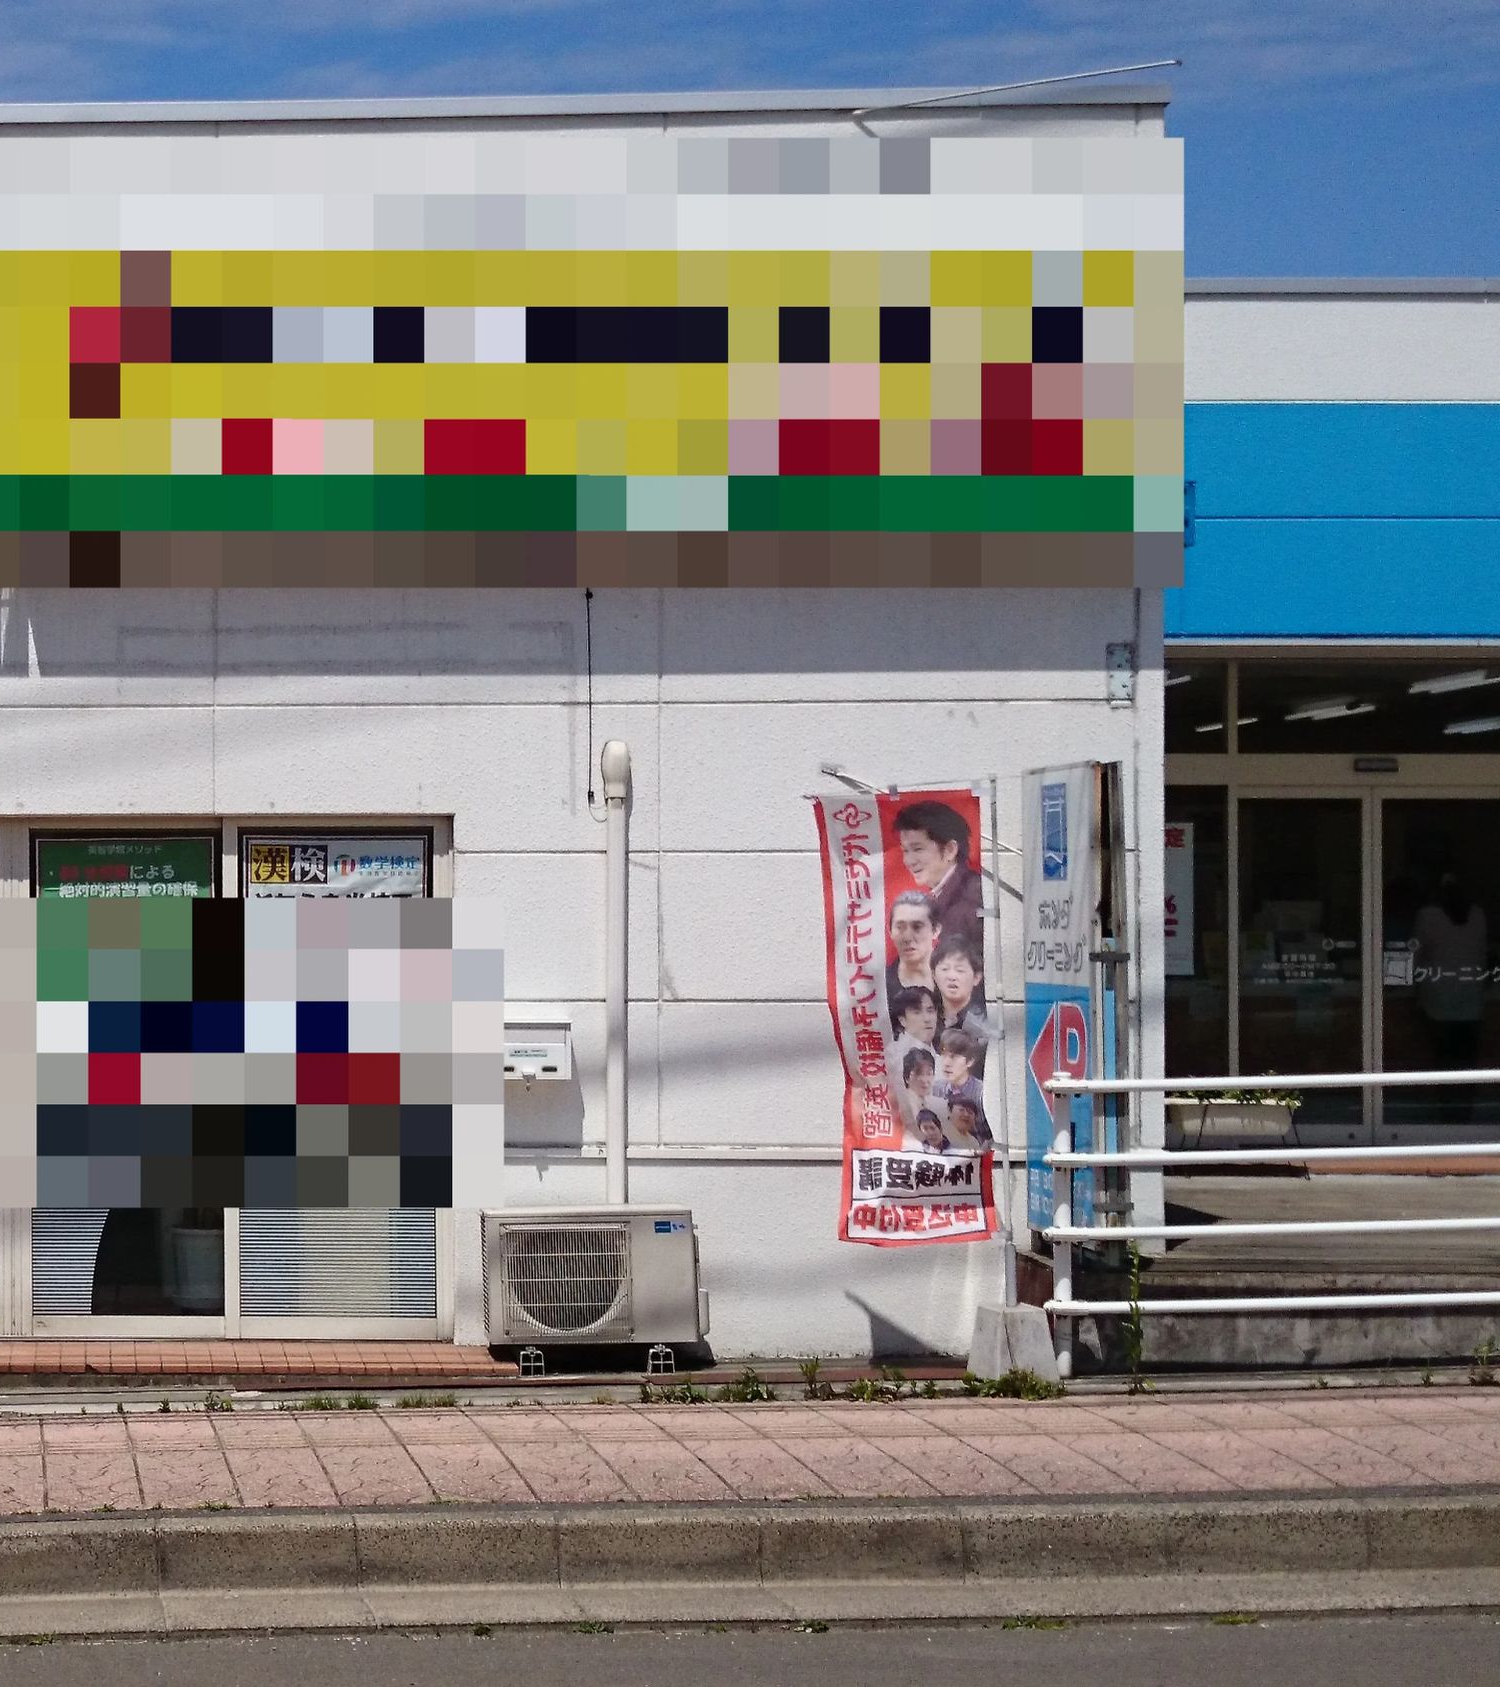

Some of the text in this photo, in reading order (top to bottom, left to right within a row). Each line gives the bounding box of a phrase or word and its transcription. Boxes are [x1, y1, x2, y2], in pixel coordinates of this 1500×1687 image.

[252, 846, 327, 882] 漢検
[358, 855, 420, 870] 数学検定
